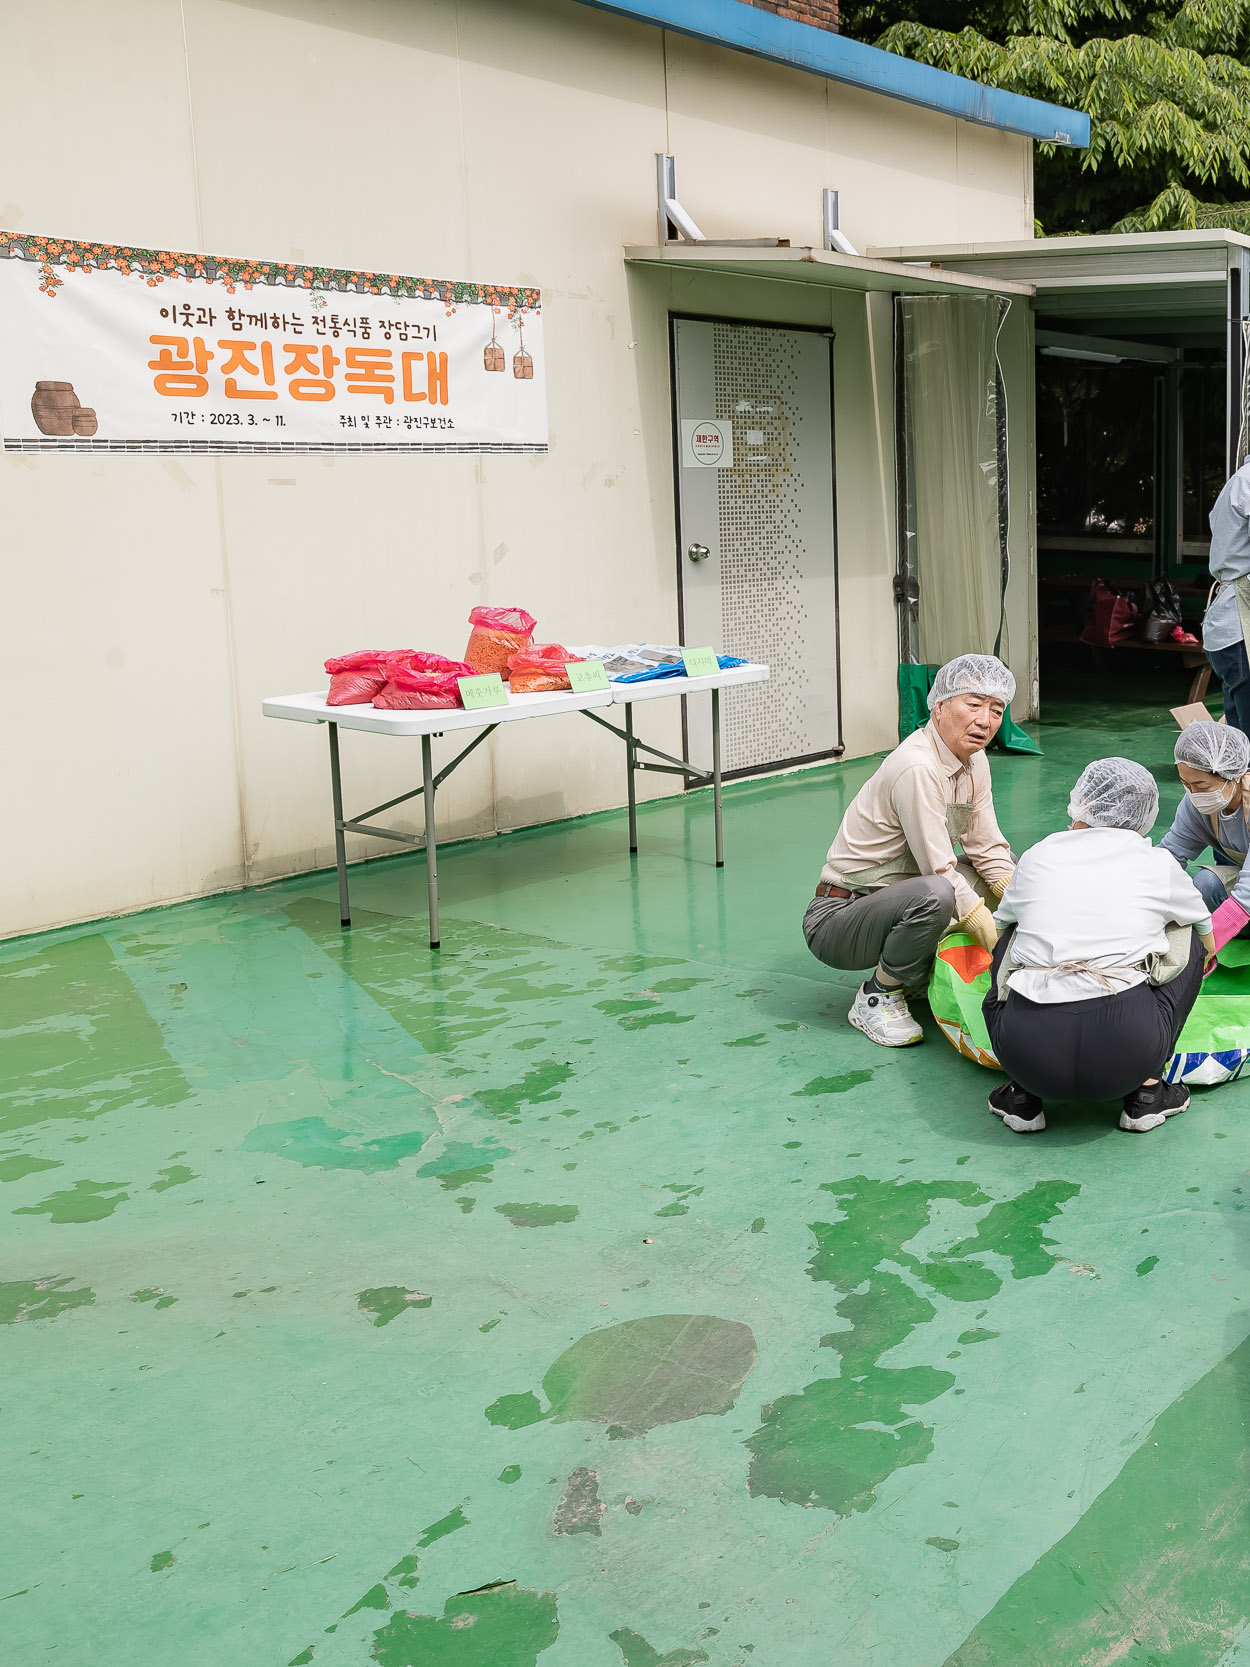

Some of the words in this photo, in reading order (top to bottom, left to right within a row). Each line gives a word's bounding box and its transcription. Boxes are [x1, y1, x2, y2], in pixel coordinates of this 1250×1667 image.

[159, 303, 217, 328] 이웃과
[225, 307, 304, 334] 함께하는
[311, 314, 372, 340] 전통식품
[378, 320, 437, 342] 장담그기
[148, 334, 449, 406] 광진장독대
[171, 411, 196, 425] 기간
[209, 413, 243, 426] 2023.
[247, 413, 258, 426] 3.
[275, 415, 286, 427] 11.
[340, 415, 357, 428] 주최
[361, 415, 370, 429] 및
[375, 415, 392, 429] 주관
[403, 416, 455, 430] 광진구보건소
[696, 434, 719, 444] 제한구역
[689, 655, 712, 667] 다시마
[575, 670, 602, 682] 고추씨
